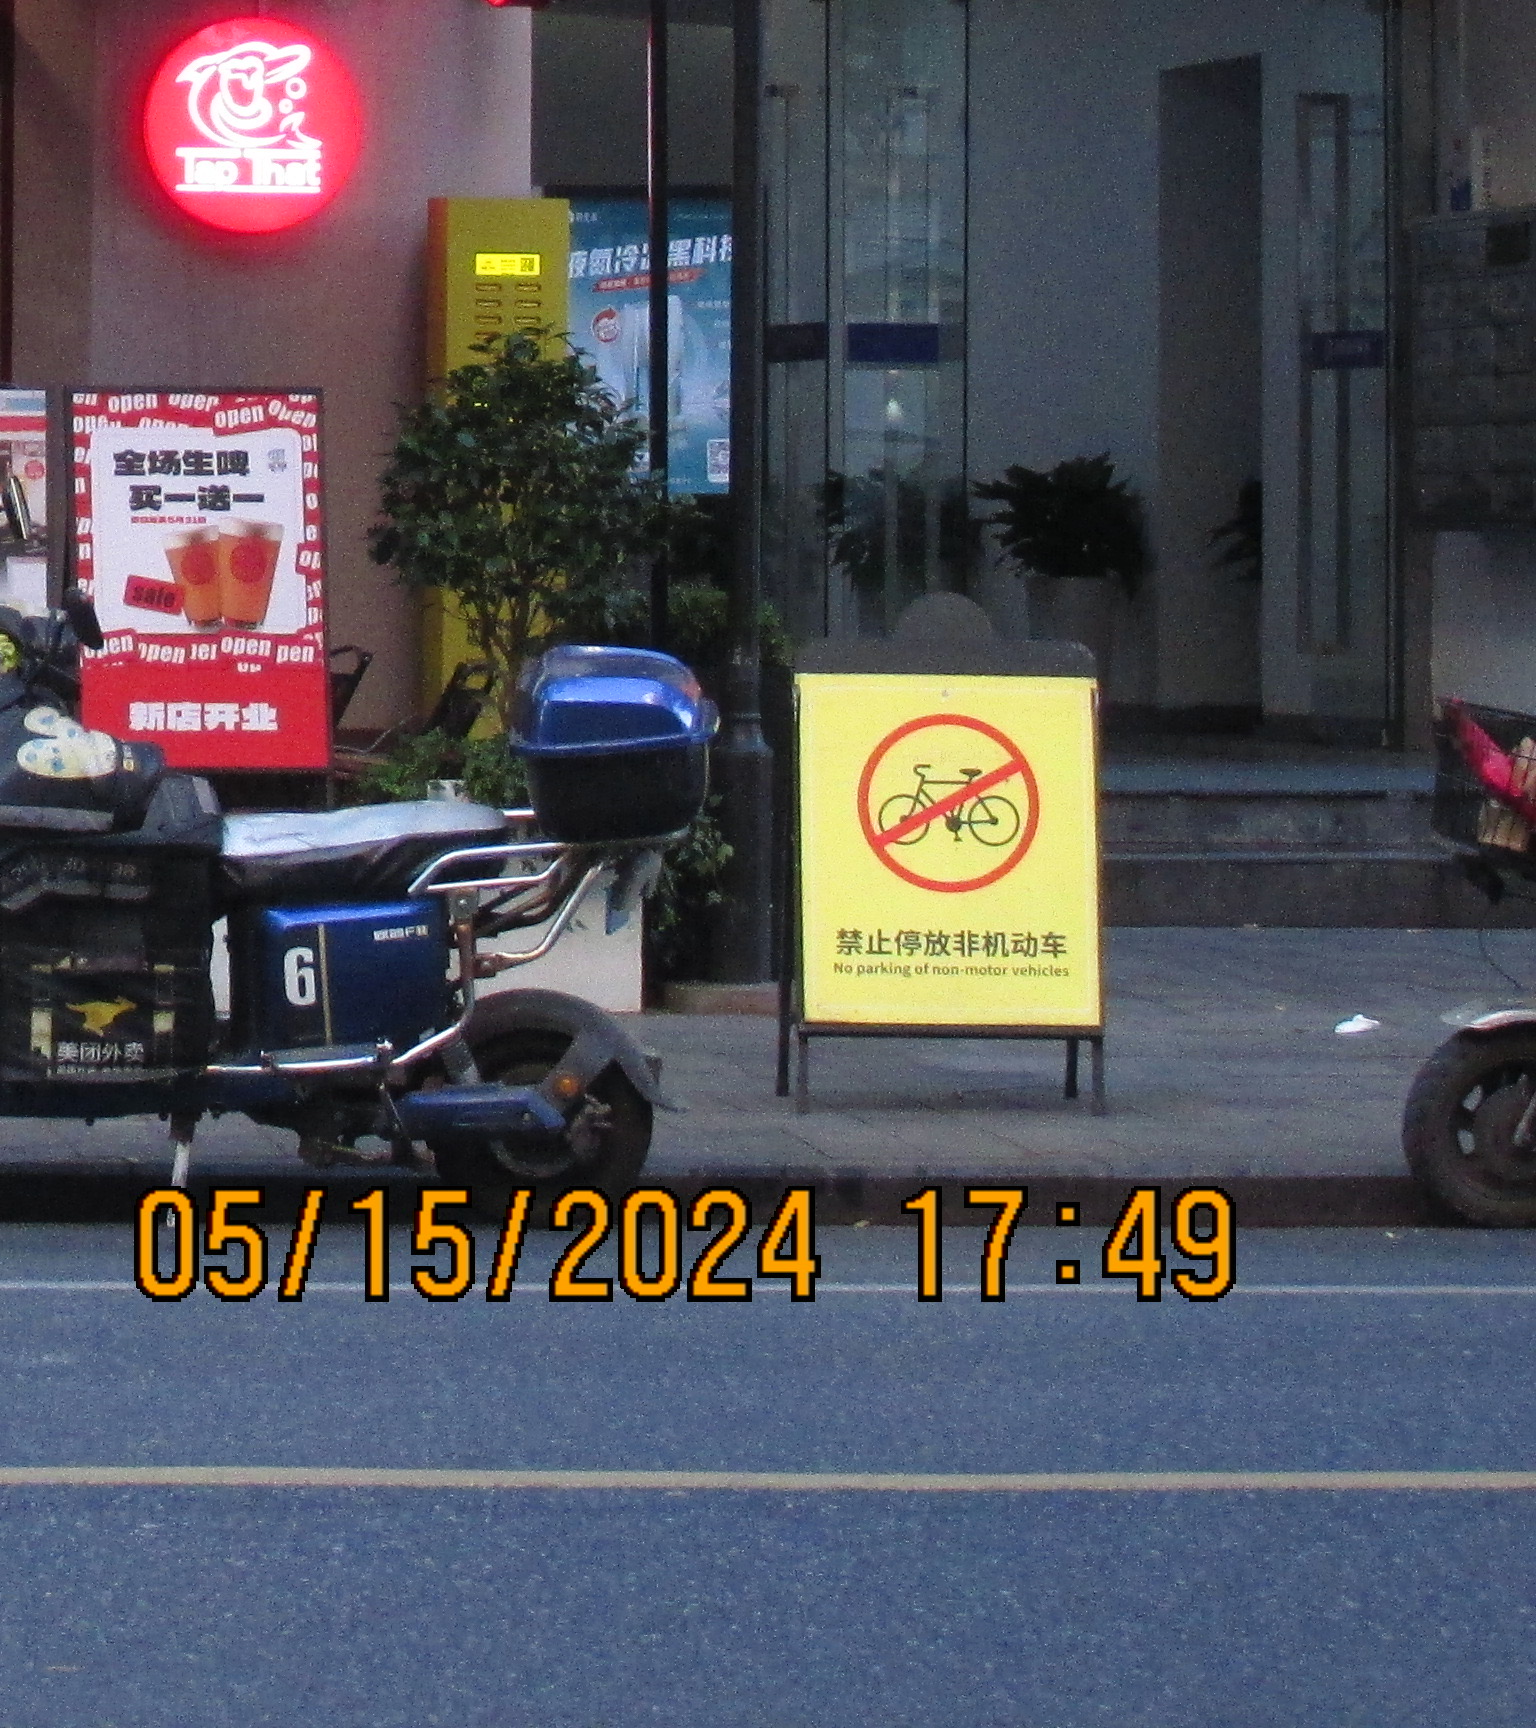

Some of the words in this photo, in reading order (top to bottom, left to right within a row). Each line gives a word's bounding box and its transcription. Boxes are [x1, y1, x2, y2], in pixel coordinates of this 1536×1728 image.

[175, 147, 242, 190] Tap
[244, 148, 322, 188] That
[108, 392, 158, 414] open
[268, 399, 317, 428] open
[214, 405, 265, 429] open
[112, 449, 251, 476] 全场生啤
[129, 484, 265, 511] 买一送一
[131, 582, 177, 609] sale
[220, 635, 273, 658] open
[129, 702, 278, 732] 新店开业
[835, 928, 1068, 959] 禁止停放非机动车
[282, 945, 318, 1007] 6
[833, 962, 853, 975] No
[857, 963, 912, 978] parking
[915, 962, 930, 976] of
[932, 965, 1008, 977] non-motor
[1011, 964, 1070, 978] vehicles
[56, 1039, 146, 1064] 美团外卖
